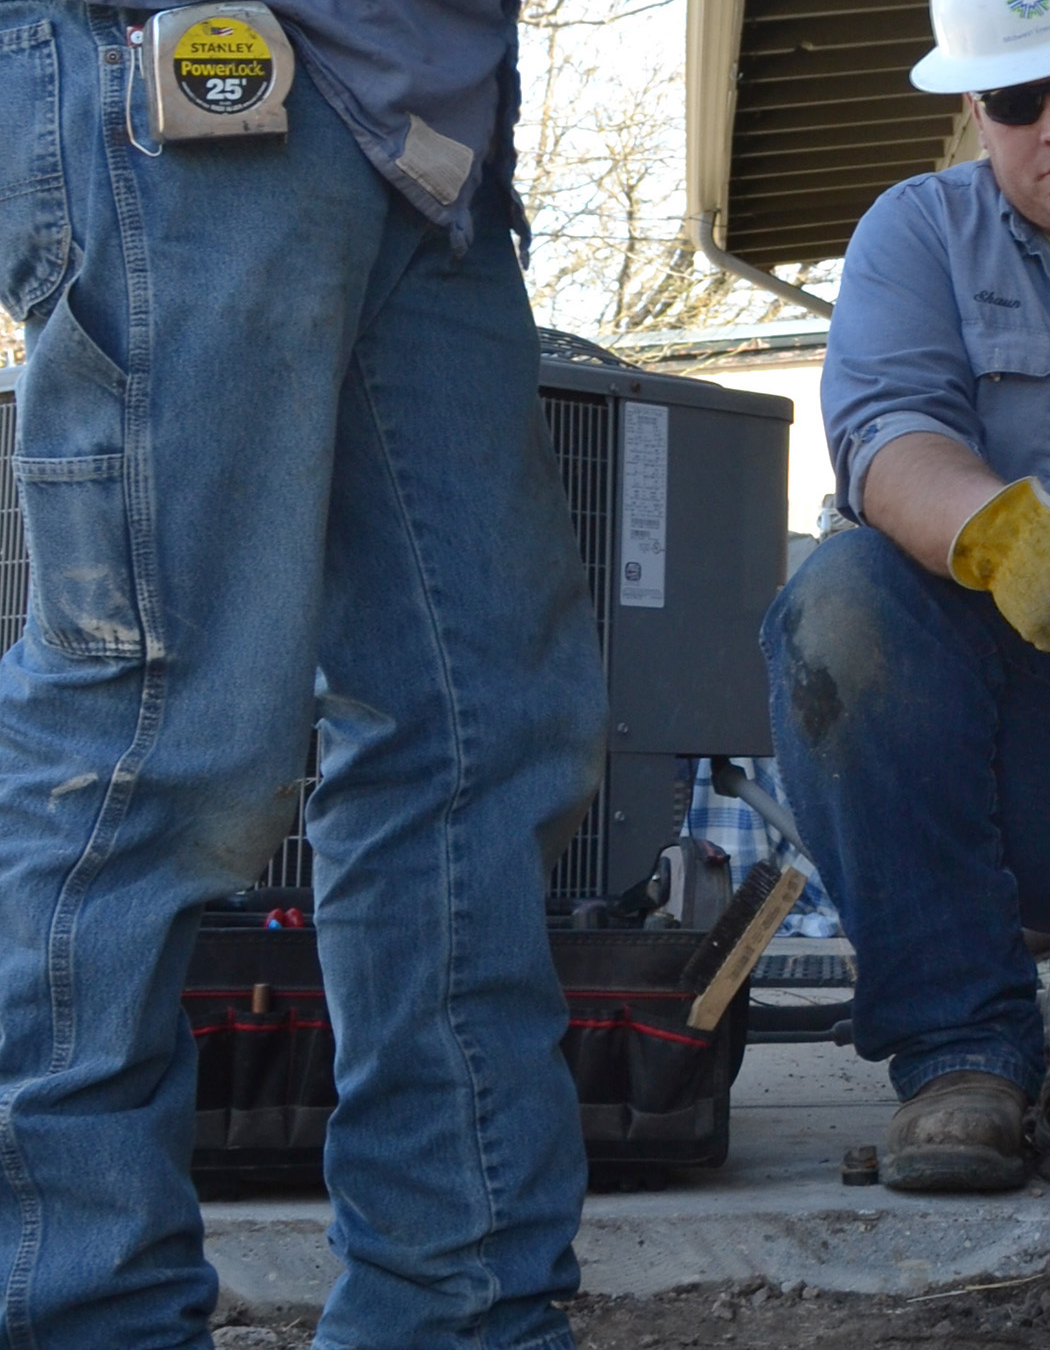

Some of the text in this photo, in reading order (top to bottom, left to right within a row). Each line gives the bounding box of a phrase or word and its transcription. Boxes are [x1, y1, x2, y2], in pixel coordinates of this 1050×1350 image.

[190, 43, 253, 53] STANLEY
[181, 60, 265, 76] PowerLock
[205, 78, 247, 100] 25'
[973, 290, 1021, 308] Shaun
